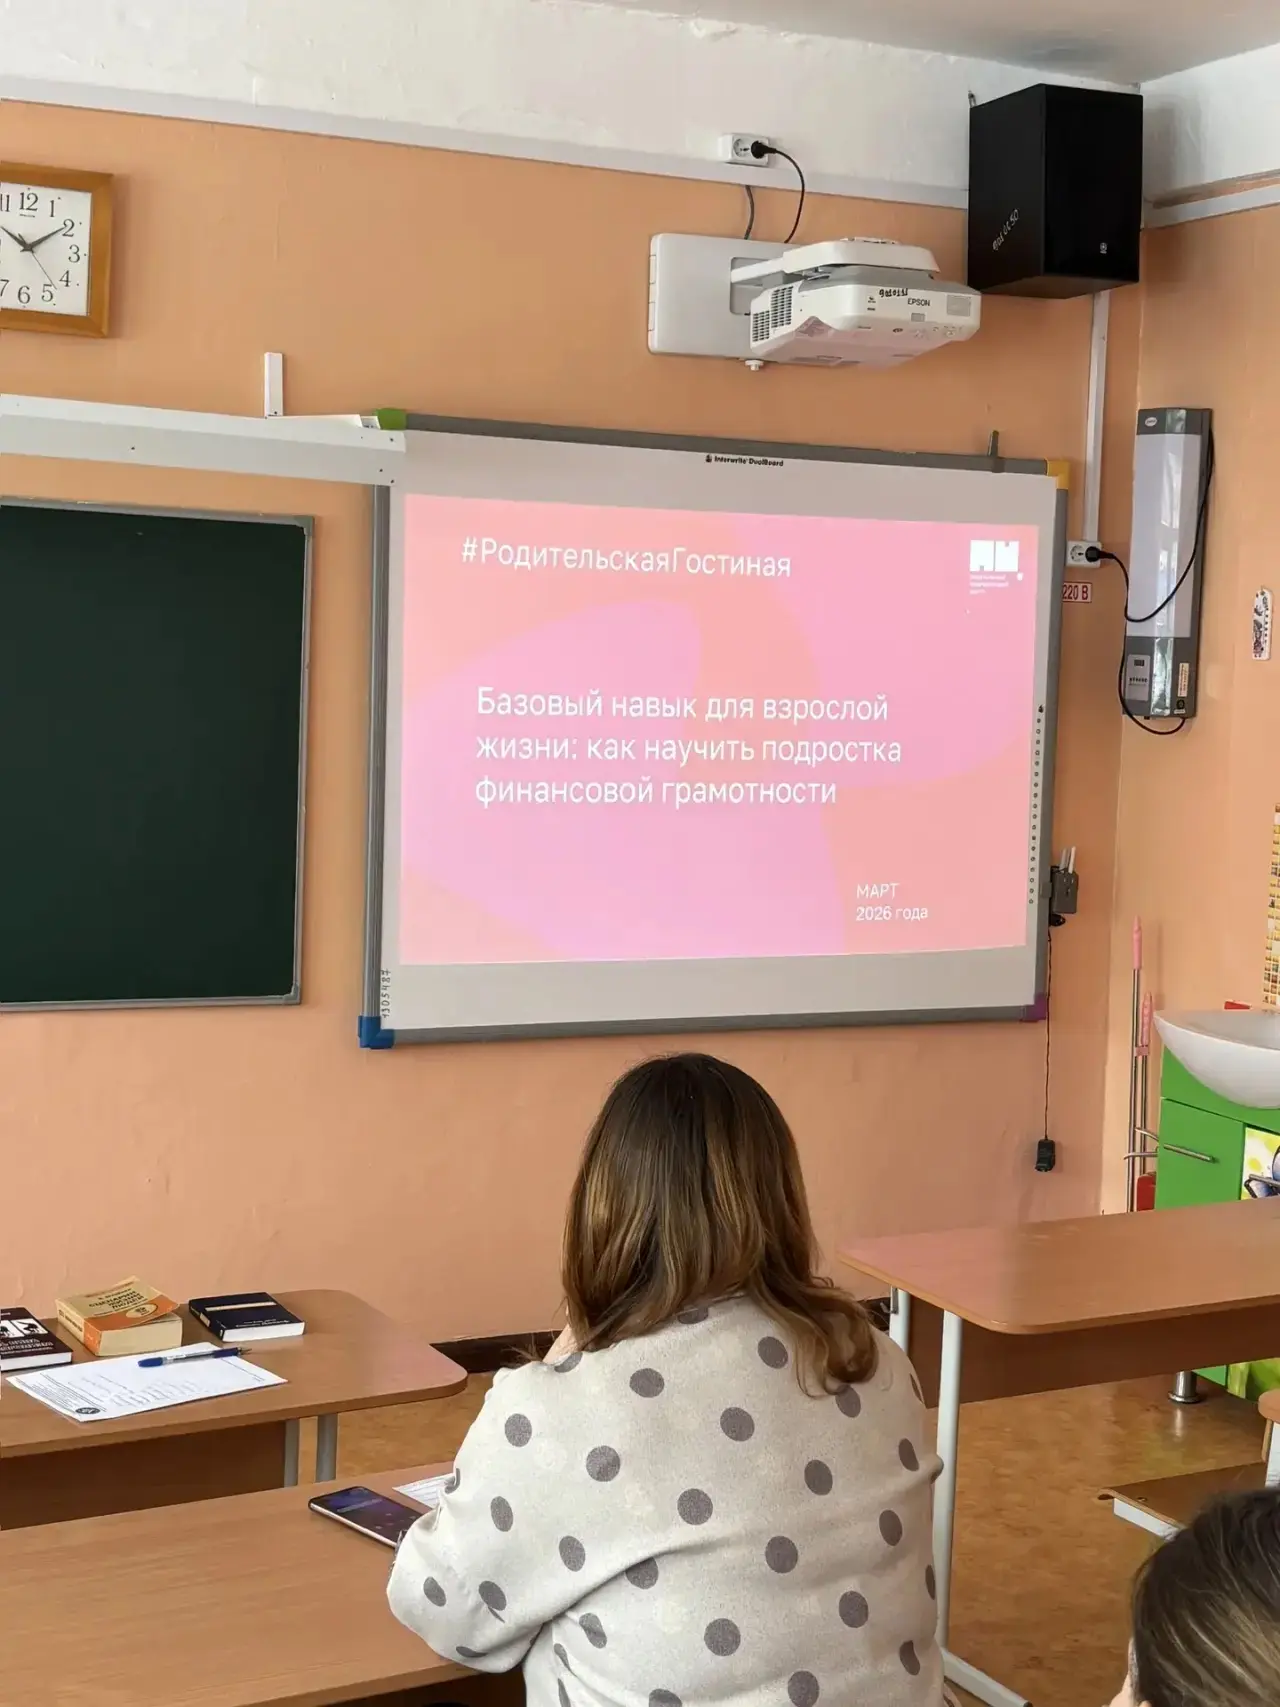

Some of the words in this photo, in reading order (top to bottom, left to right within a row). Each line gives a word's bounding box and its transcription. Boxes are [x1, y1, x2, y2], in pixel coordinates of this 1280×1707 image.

[19, 192, 38, 212] 12
[49, 199, 55, 218] 1
[62, 218, 75, 238] 2
[68, 244, 80, 263] 3
[0, 278, 10, 297] 7
[59, 269, 71, 288] 4
[17, 285, 31, 304] 6
[41, 283, 54, 303] 5
[907, 297, 931, 307] EPSON
[714, 455, 747, 464] Interwrite
[748, 457, 784, 467] DualBoard
[461, 536, 792, 578] #РодительскаяГостиная
[1062, 584, 1079, 601] 220
[1081, 584, 1089, 601] В
[476, 685, 603, 718] Базовый
[611, 695, 697, 719] навык
[704, 697, 755, 723] для
[763, 694, 889, 725] взрослой
[475, 736, 578, 760] жизни:
[587, 737, 636, 761] как
[644, 738, 755, 768] научить
[762, 739, 902, 769] подростка
[475, 774, 654, 808] финансовой
[661, 781, 837, 809] грамотности
[856, 882, 900, 899] МАРТ
[855, 905, 892, 921] 2026
[895, 907, 929, 922] года
